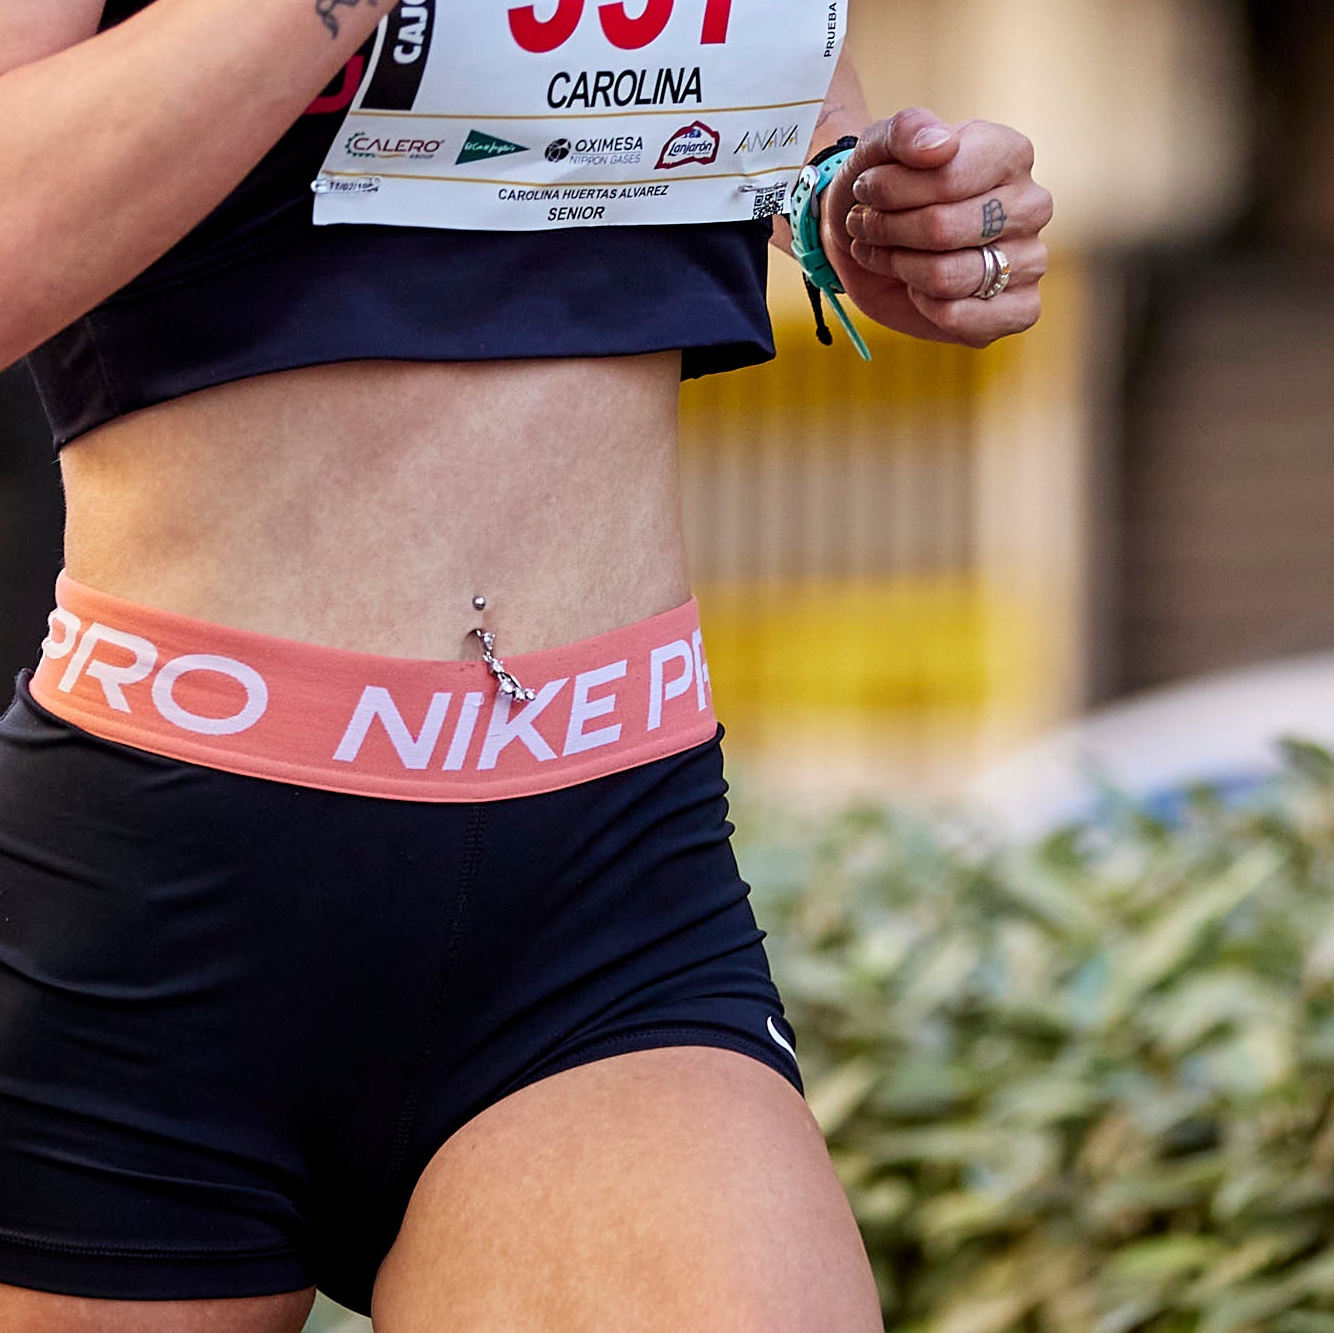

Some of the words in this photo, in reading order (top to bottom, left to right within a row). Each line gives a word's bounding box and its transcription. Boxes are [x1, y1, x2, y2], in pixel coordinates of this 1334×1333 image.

[824, 2, 837, 58] PRUEBA
[547, 66, 702, 109] CAROLINA
[353, 137, 441, 153] CALERO
[575, 136, 643, 152] OXIMESA
[733, 124, 799, 154] ANAYA
[667, 140, 713, 156] Lanjarón
[570, 155, 608, 165] NIPPON
[610, 153, 641, 164] GASES
[498, 188, 560, 201] CAROLINA
[562, 188, 617, 200] HUERTAS
[618, 185, 669, 199] ALVAREZ
[547, 206, 605, 221] SENIOR
[42, 607, 268, 736] PRO
[333, 659, 627, 771] NIKE
